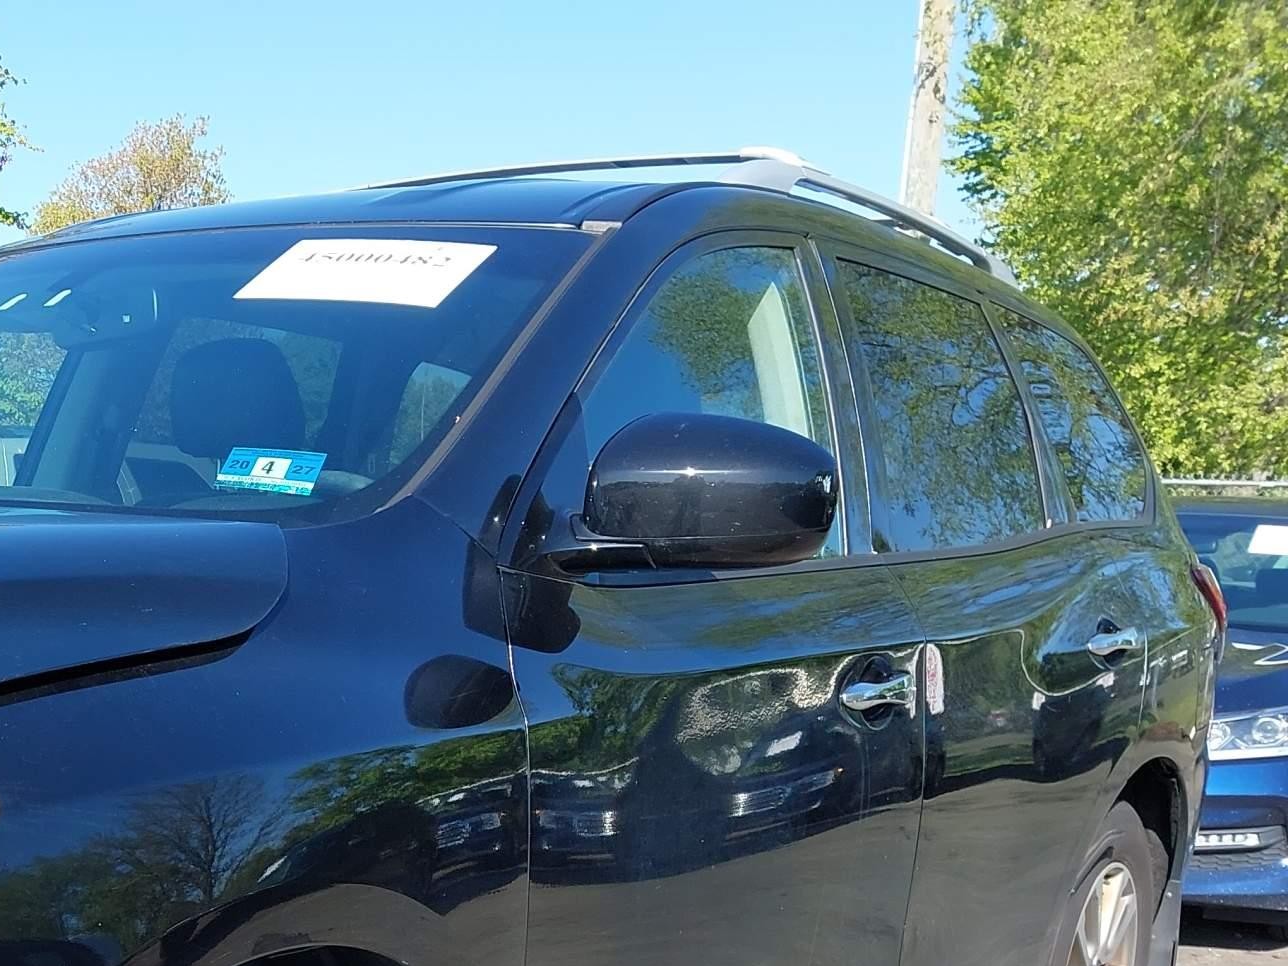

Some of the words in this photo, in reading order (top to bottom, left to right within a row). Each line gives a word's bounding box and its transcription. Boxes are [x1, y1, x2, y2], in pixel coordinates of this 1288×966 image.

[229, 459, 250, 469] 20
[261, 461, 276, 475] 4
[293, 465, 316, 475] 27
